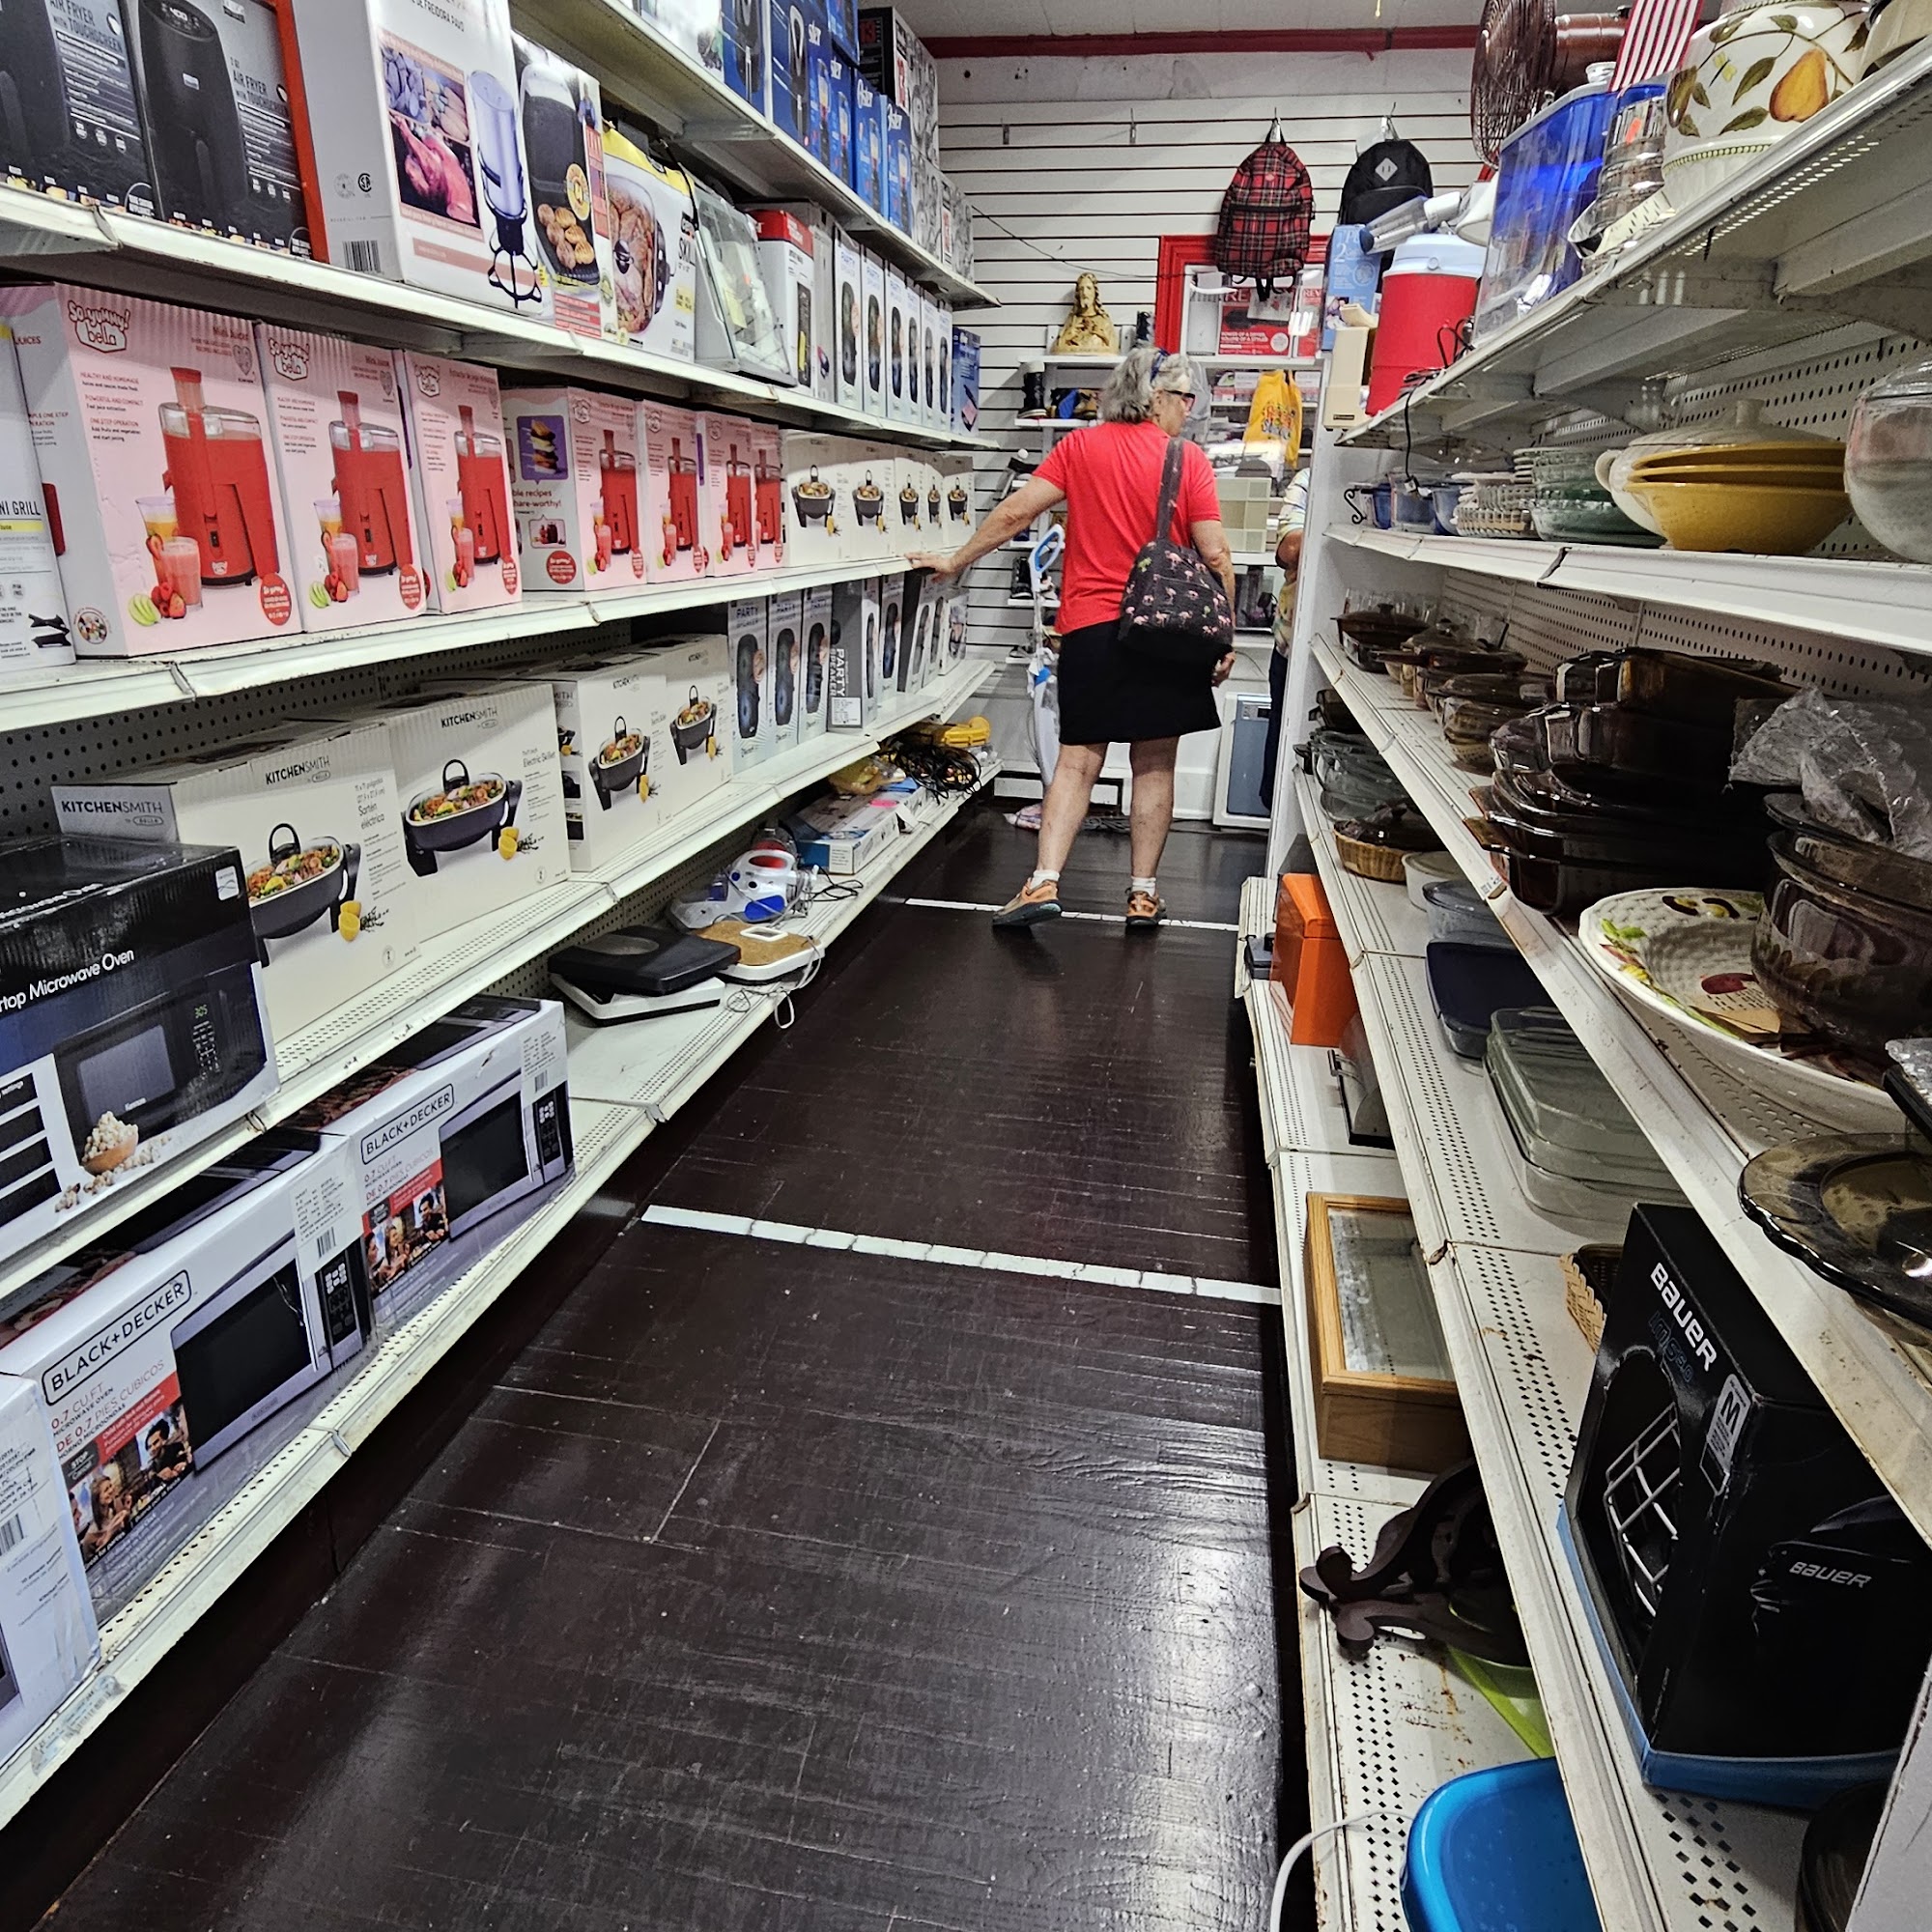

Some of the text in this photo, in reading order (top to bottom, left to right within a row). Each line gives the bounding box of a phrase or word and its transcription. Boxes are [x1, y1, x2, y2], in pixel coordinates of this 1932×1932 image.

[808, 20, 822, 46] ster
[86, 319, 117, 346] bella
[526, 489, 552, 497] recipes
[12, 500, 42, 516] GRILL
[736, 607, 758, 618] PARTY
[836, 648, 846, 696] PARTY
[440, 706, 497, 728] KITCHENSMITH
[266, 755, 330, 785] KITCHENSMITH
[61, 800, 163, 814] KITCHENSMITH
[30, 963, 100, 1001] Microwave
[101, 948, 134, 972] Oven
[365, 1092, 451, 1155] BLACK+DECKER
[1650, 1262, 1717, 1372] BAUER
[50, 1281, 185, 1392] BLACK+DECKER
[51, 1408, 69, 1430] 0.7
[53, 1387, 114, 1437] MICROWAVE OVEN
[56, 1359, 165, 1453] DE 0.7 PIES CUBICOS
[58, 1403, 127, 1460] HORNO MICROONDAS
[1789, 1560, 1872, 1589] BAUER
